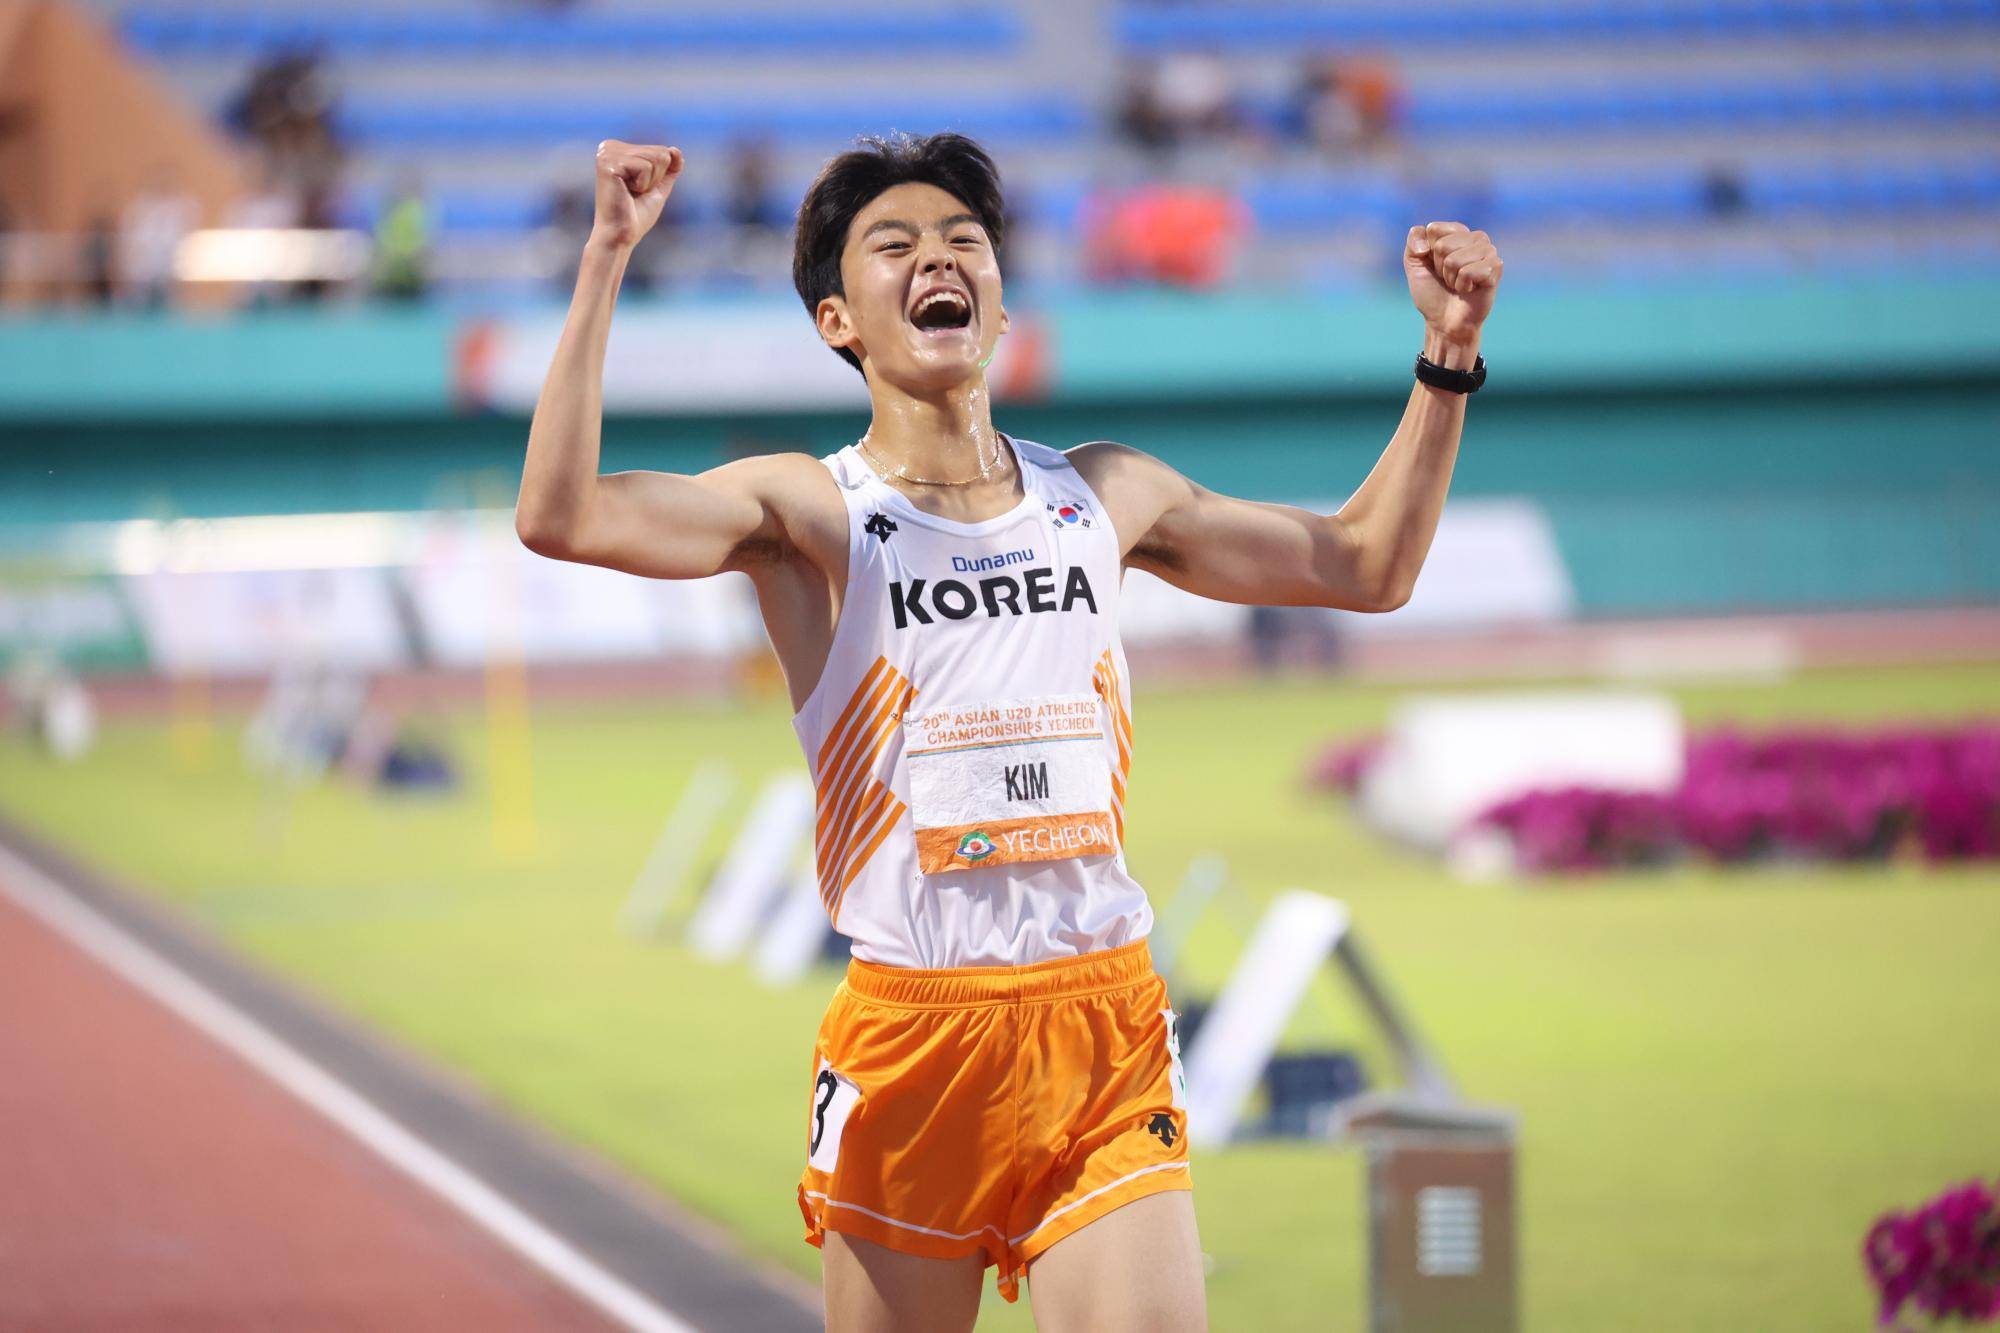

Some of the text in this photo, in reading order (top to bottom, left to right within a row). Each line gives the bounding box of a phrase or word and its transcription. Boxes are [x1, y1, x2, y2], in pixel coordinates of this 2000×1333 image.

[952, 549, 1034, 572] Dunamu
[889, 566, 1098, 629] KOREA
[923, 701, 1096, 730] 20th ASIAN U20 ATHLETICS
[927, 717, 1095, 745] CHAMPIONSHIPS YECHEON
[1004, 762, 1050, 802] KIM
[1002, 824, 1110, 853] YECHEON
[810, 1069, 838, 1158] 3
